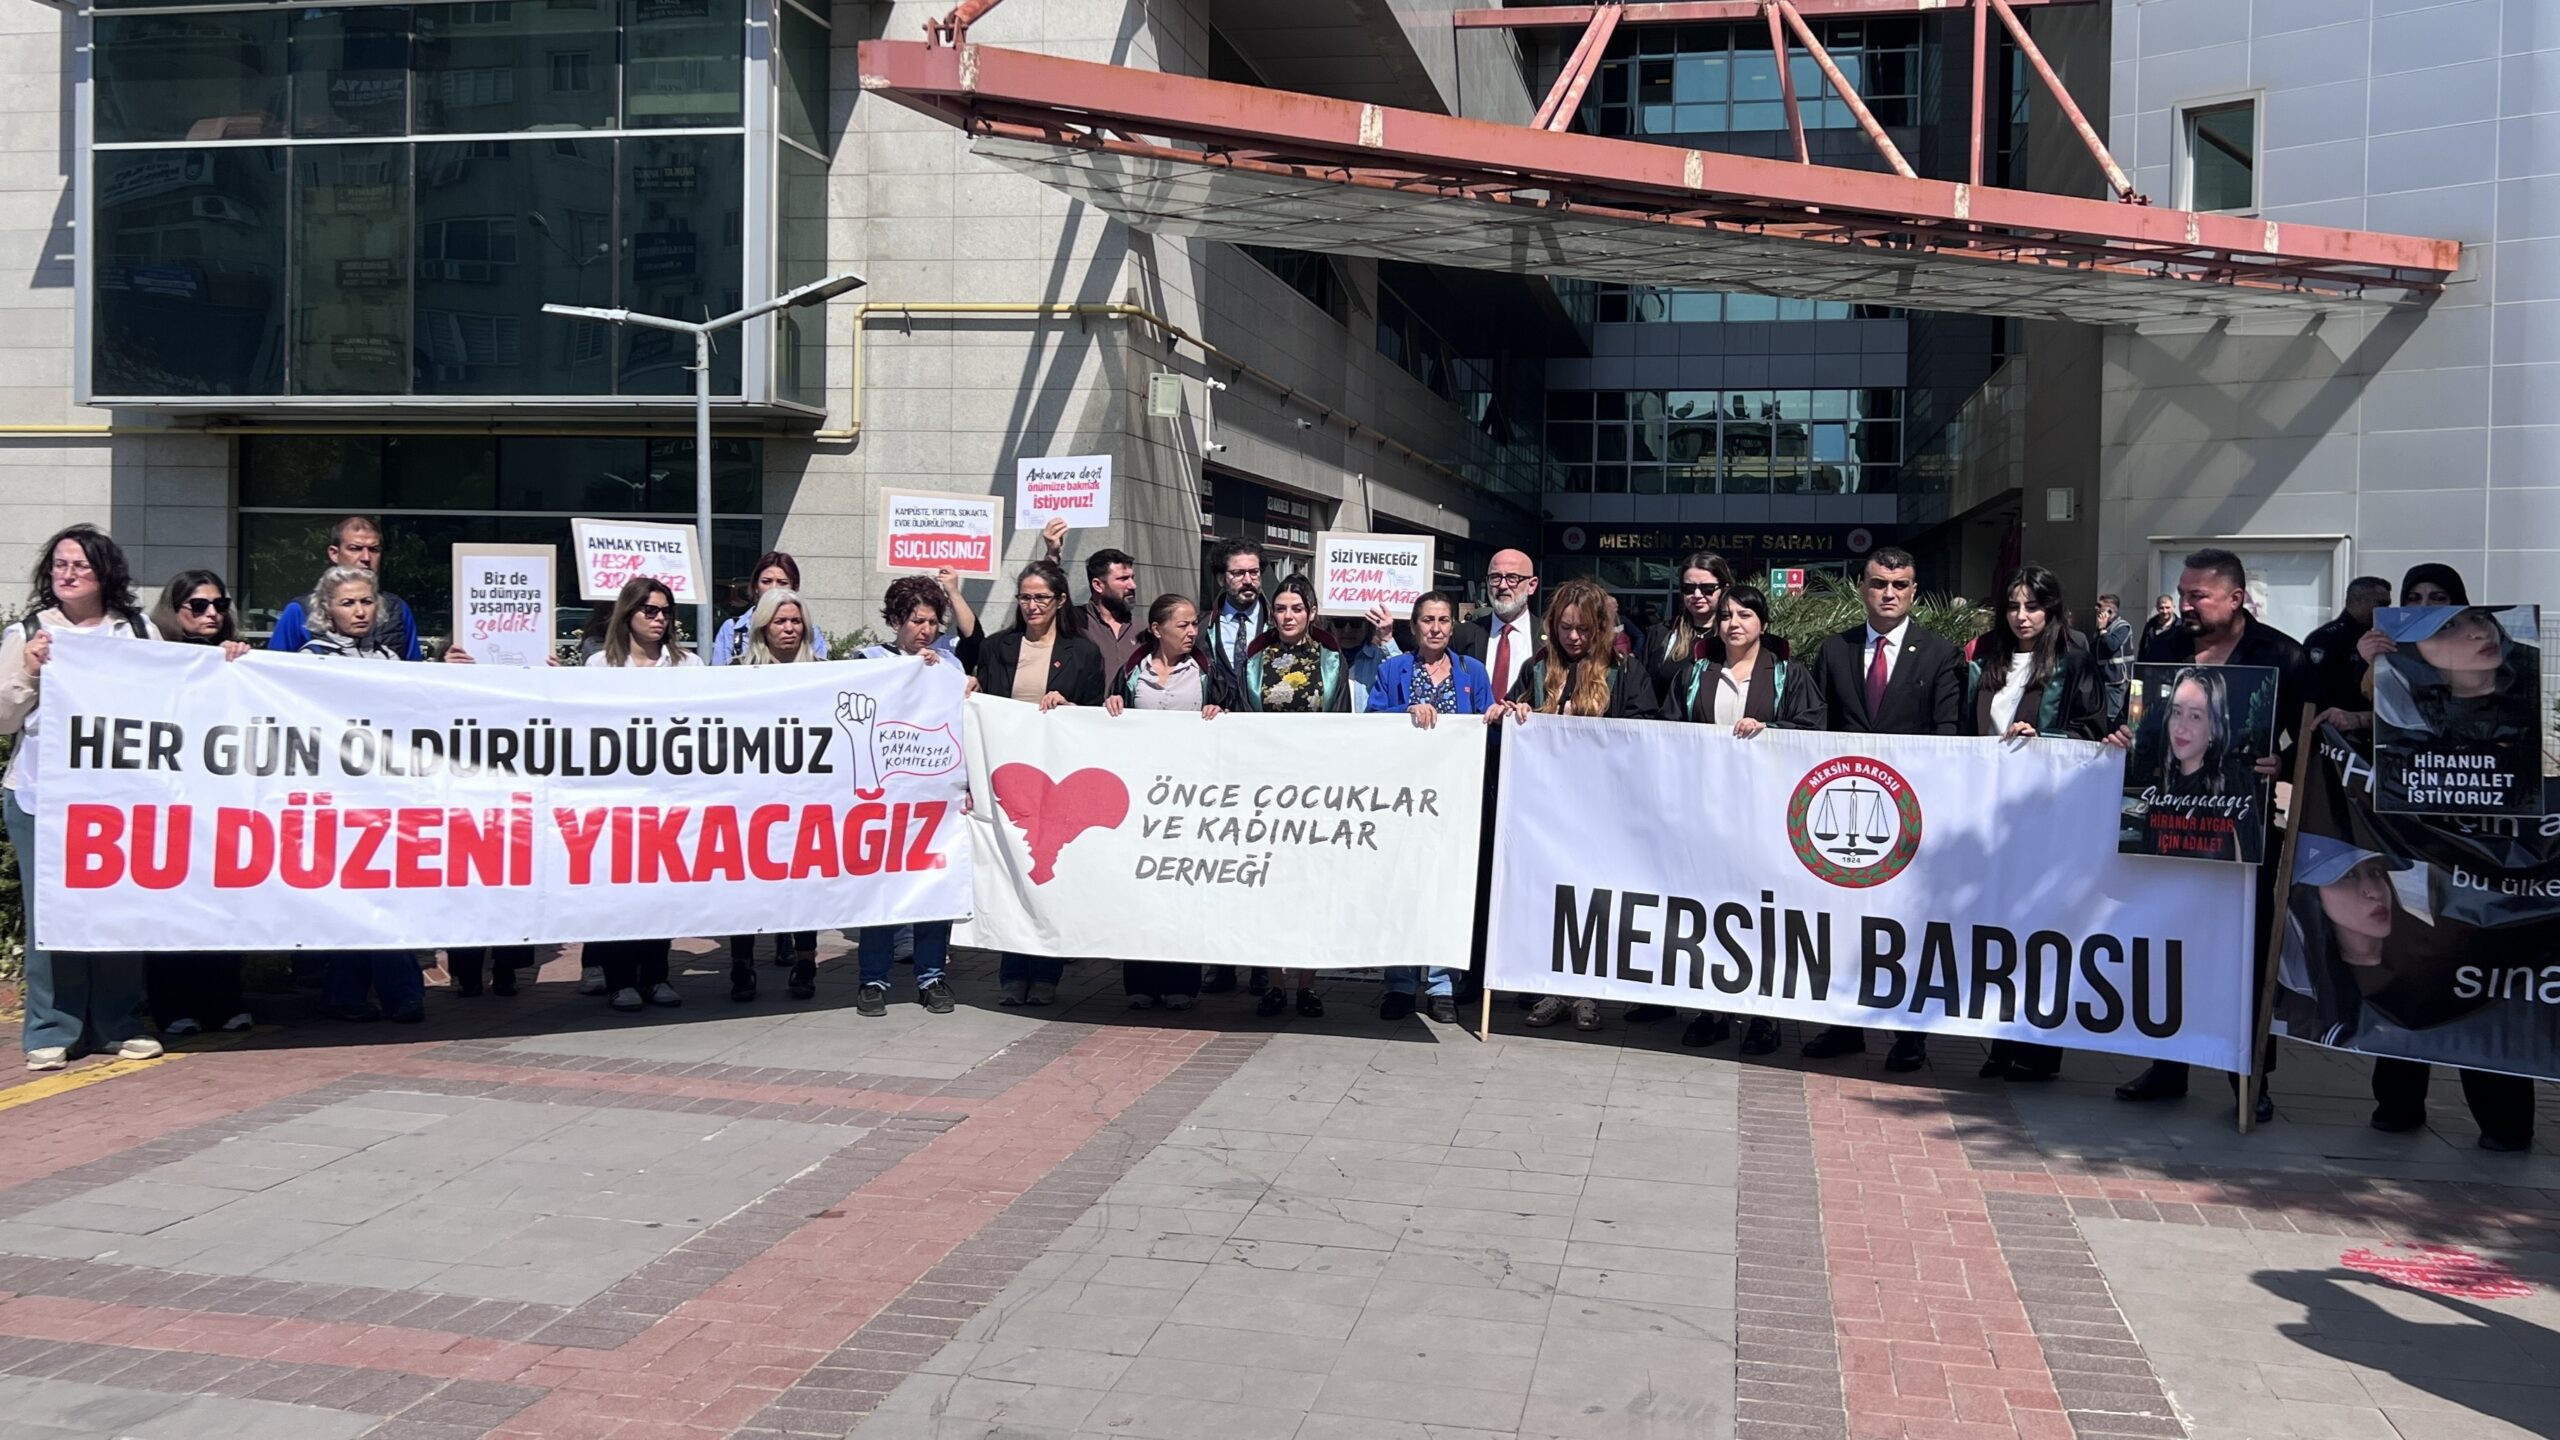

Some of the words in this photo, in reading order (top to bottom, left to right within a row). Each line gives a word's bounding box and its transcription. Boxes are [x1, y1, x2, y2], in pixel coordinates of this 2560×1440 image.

[1028, 481, 1065, 492] önümüze
[1067, 480, 1100, 491] bakmak
[1033, 493, 1093, 511] istiyoruz!
[895, 519, 911, 528] EVDE
[588, 537, 634, 552] ANMAK
[635, 539, 682, 554] YETMEZ
[1600, 530, 1671, 548] MERSİN
[1680, 535, 1755, 549] ADALET
[1762, 535, 1832, 550] SARAYI
[895, 540, 986, 561] SUÇLUSUNUZ
[1331, 549, 1353, 564] SİZİ
[1355, 551, 1418, 567] YENECEĞİZ
[592, 553, 645, 571] HESAP
[484, 572, 506, 585] Biz
[510, 572, 528, 585] de
[470, 587, 486, 599] bu
[489, 587, 541, 600] dünyaya
[1328, 587, 1420, 604] KAZANACAĞIZ
[470, 602, 541, 616] yaşamaya
[471, 612, 538, 640] geldik!
[879, 730, 920, 743] KADIN
[69, 715, 183, 772] HER
[203, 716, 321, 777] GÜN
[339, 716, 834, 778] ÖLDÜRÜLDÜĞÜMÜZ
[881, 744, 950, 757] DAYANIŞMA
[885, 755, 953, 770] KOMİTELERİ
[2414, 751, 2496, 769] HİRANUR
[1808, 761, 1850, 789] MERSİN
[1855, 762, 1901, 792] BAROSU
[2402, 768, 2439, 790] İÇİN
[2444, 773, 2515, 788] ADALET
[1146, 775, 1241, 809] ÖNCE
[1253, 785, 1439, 817] ÇOCUKLAR
[2407, 787, 2504, 805] İSTİYORUZ
[2150, 811, 2196, 830] HİRANUR
[2200, 816, 2235, 833] AYGAR
[64, 802, 193, 890] BU
[213, 791, 535, 890] DÜZENİ
[553, 786, 948, 886] YIKACAĞIZ
[1141, 814, 1185, 841] VE
[1197, 816, 1379, 851] KADINLAR
[2183, 837, 2224, 852] ADALET
[1135, 852, 1273, 887] DERNEĞİ
[2452, 865, 2489, 891] bu
[1551, 884, 1831, 1001] MERSİN
[1858, 916, 2183, 1038] BAROSU
[2453, 965, 2560, 1004] sına
